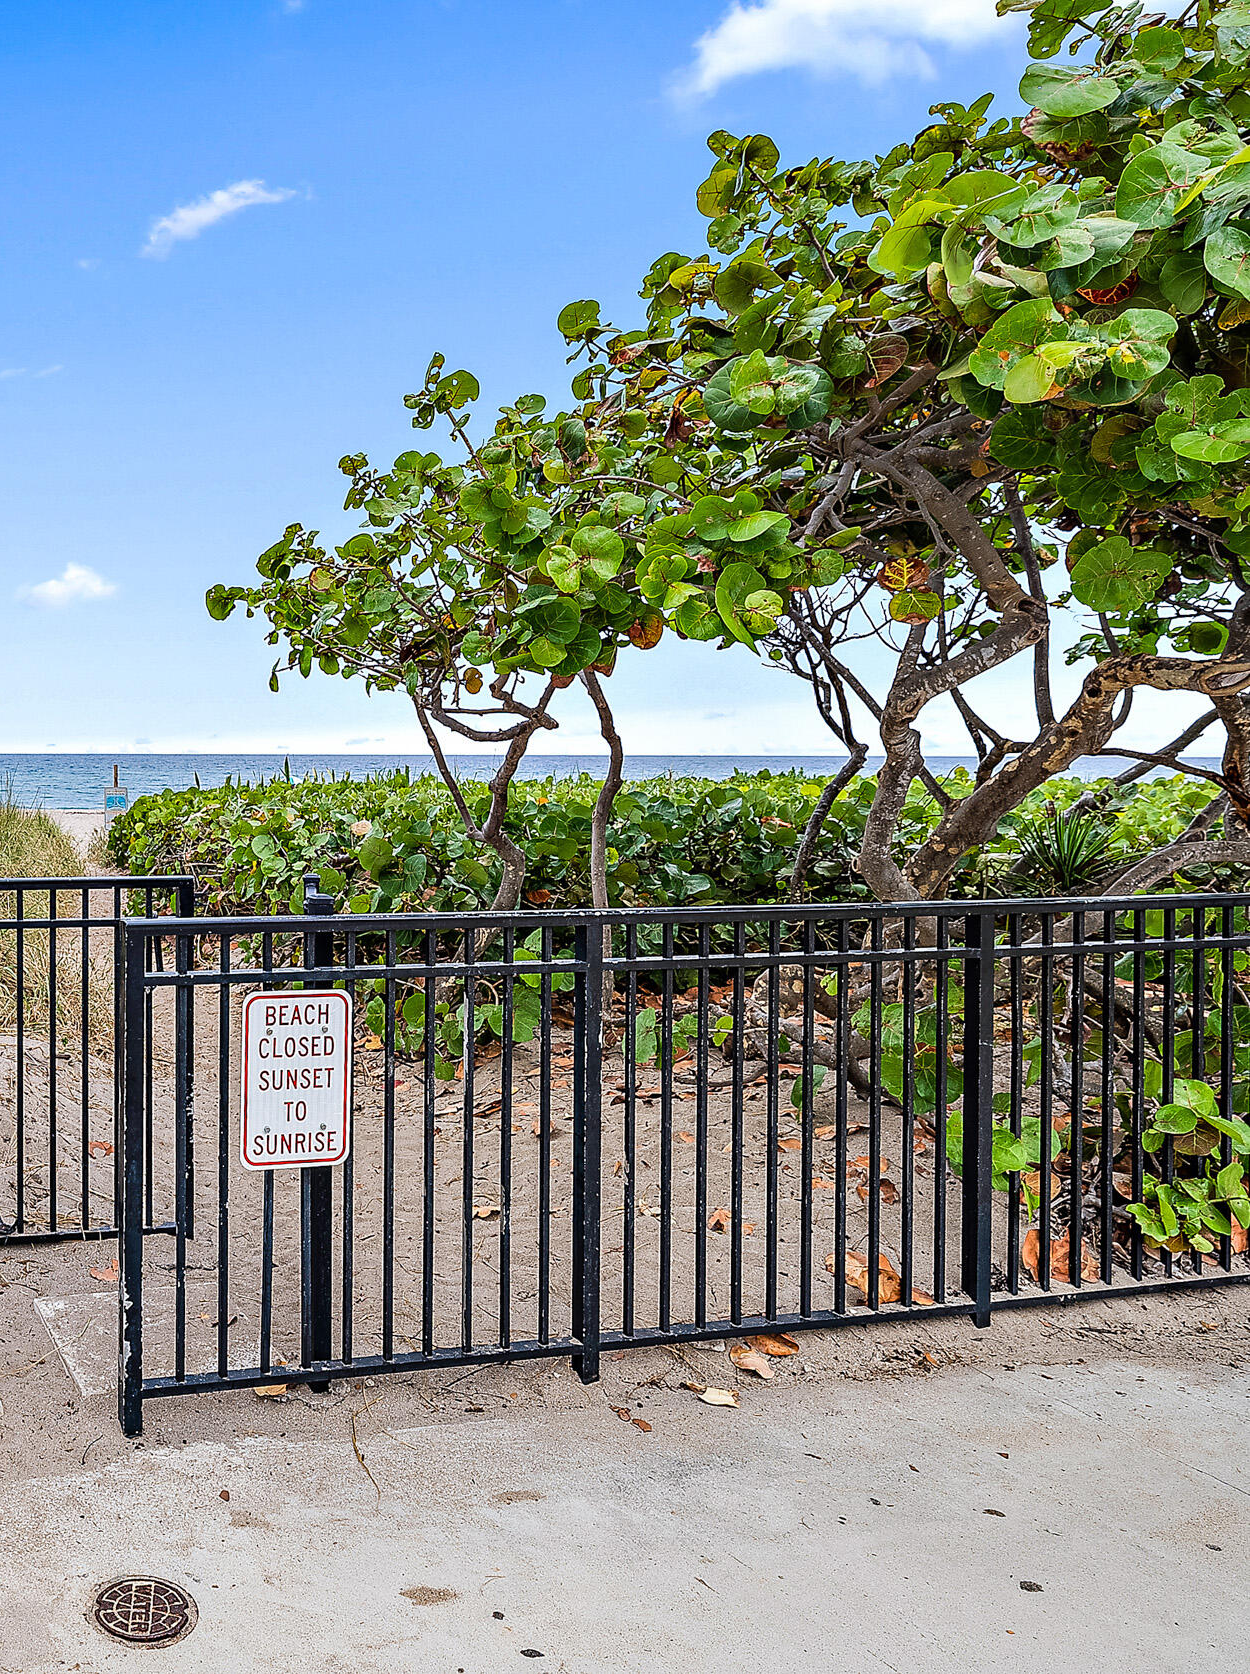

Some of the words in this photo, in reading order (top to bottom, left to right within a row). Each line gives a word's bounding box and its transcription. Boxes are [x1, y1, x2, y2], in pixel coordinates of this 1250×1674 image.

[265, 1004, 329, 1026] BEACH
[259, 1036, 335, 1059] CLOSED
[258, 1068, 335, 1091] SUNSET
[284, 1101, 307, 1122] TO
[253, 1131, 337, 1156] SUNRISE
[130, 1584, 153, 1632] WATER
